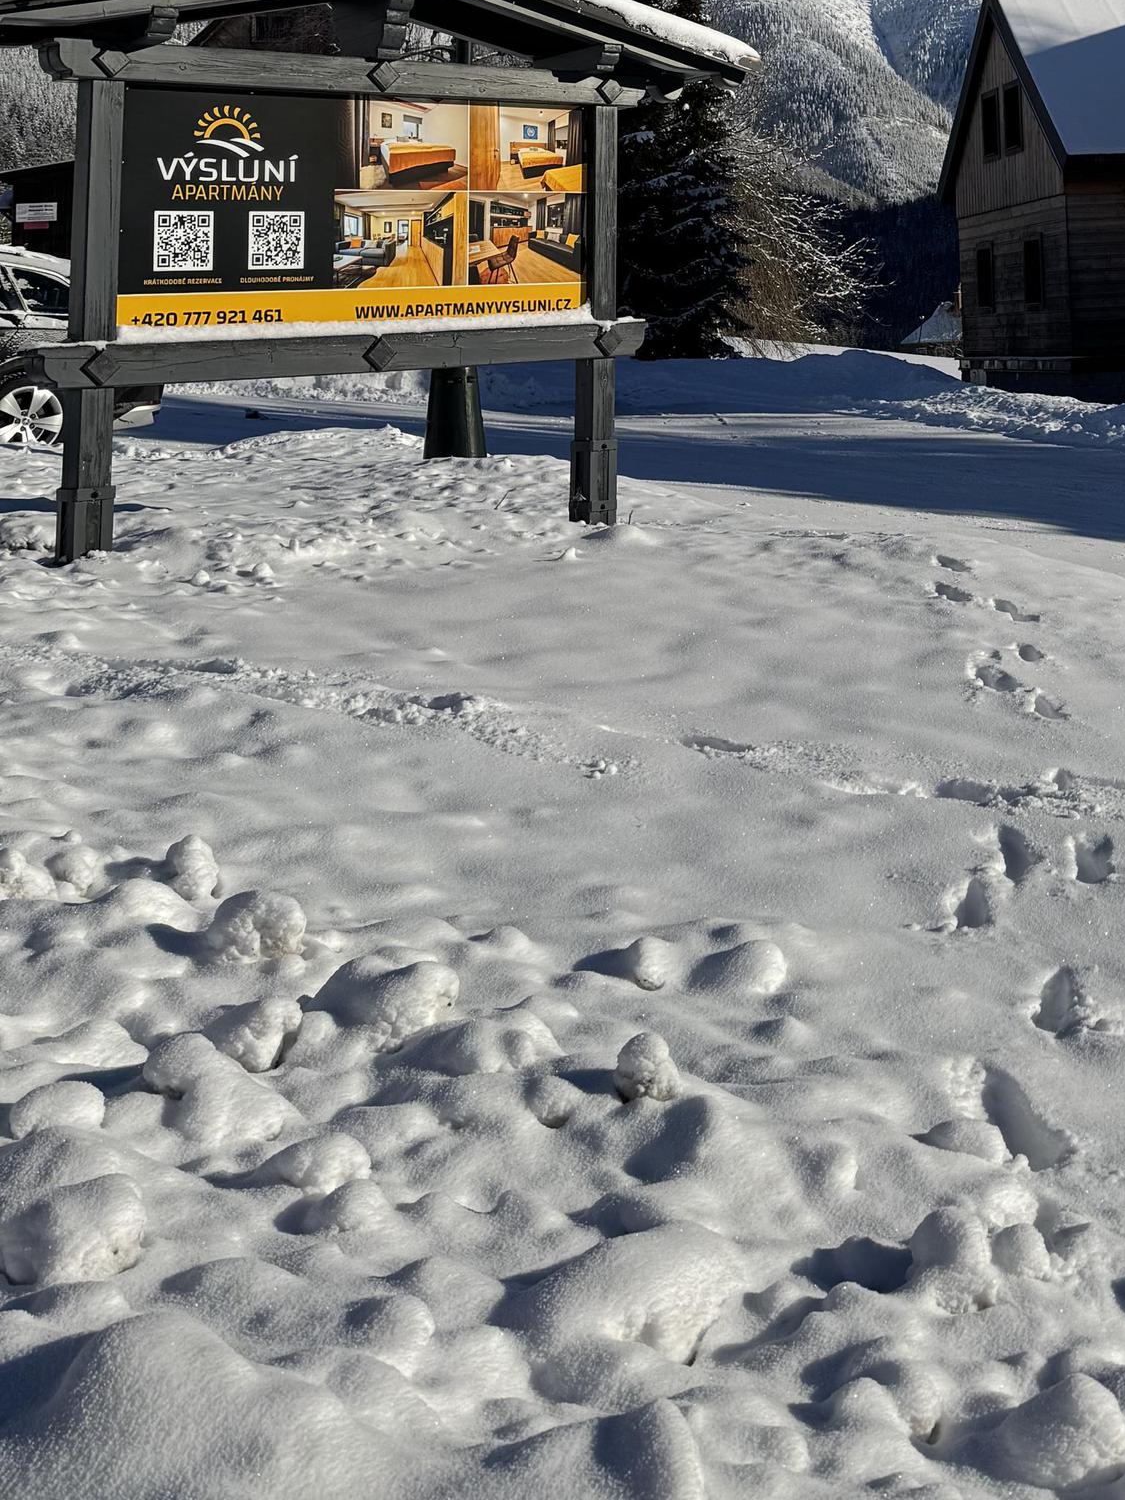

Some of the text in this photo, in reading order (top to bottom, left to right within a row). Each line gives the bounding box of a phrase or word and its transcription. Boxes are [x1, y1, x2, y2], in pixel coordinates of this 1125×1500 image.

[157, 151, 299, 182] VÝSLUNÍ
[171, 181, 284, 201] APARTMÁNY
[131, 309, 284, 327] +420 777 921 461
[355, 298, 572, 319] WWW.APARTMANYVYSLUNI.CZ
